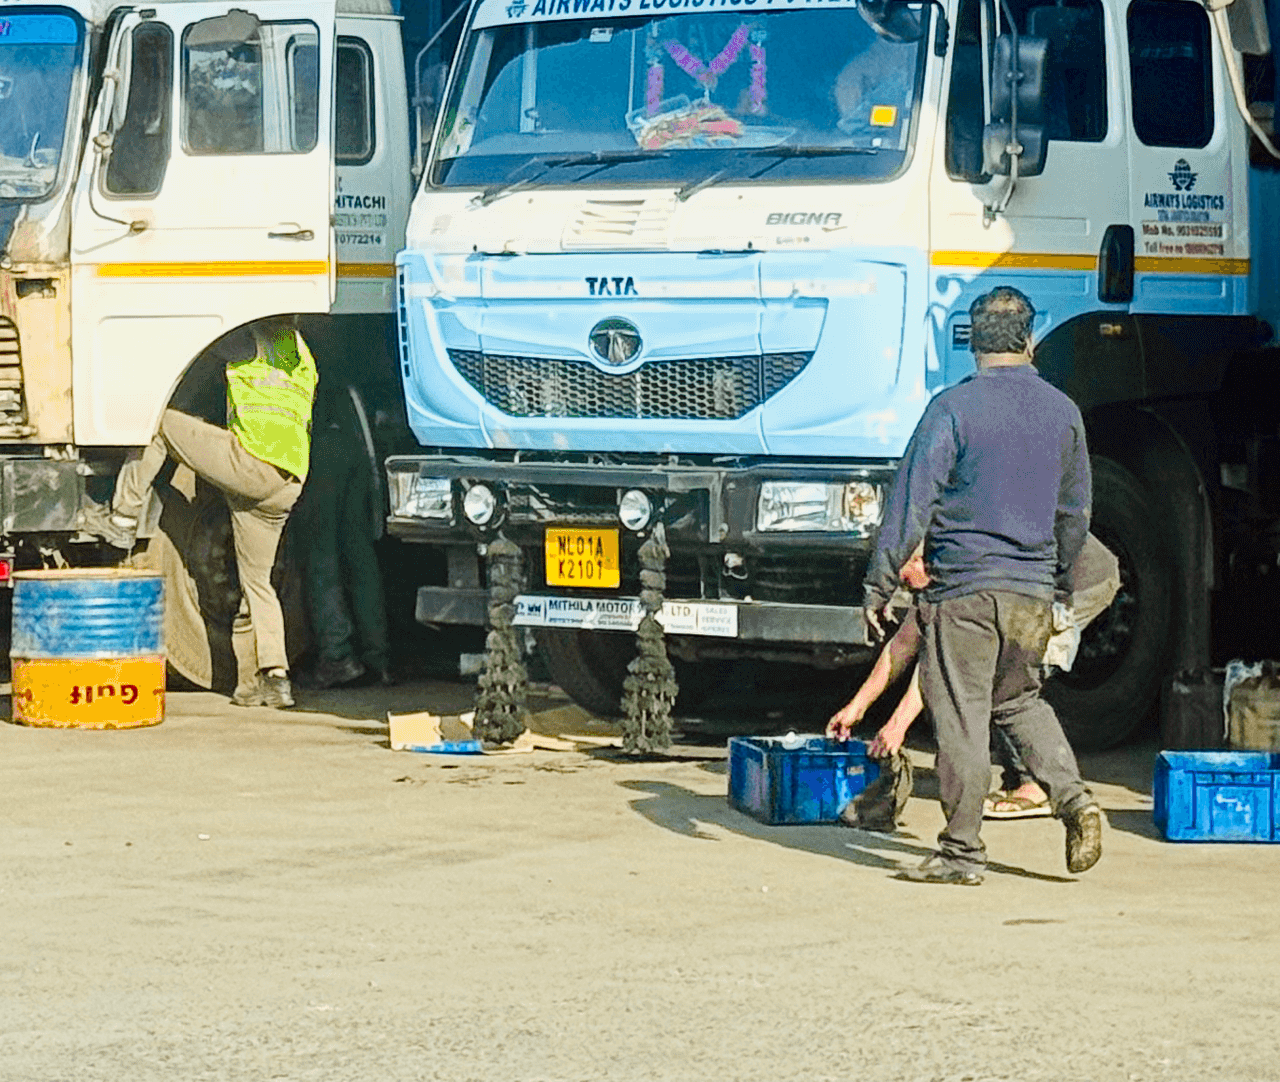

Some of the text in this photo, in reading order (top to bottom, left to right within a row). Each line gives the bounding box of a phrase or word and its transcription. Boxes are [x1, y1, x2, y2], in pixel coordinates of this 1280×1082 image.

[1144, 193, 1225, 211] AIRWAYS LOGISTICS
[584, 276, 639, 296] TATA
[558, 535, 604, 557] NL01A
[558, 560, 603, 581] K2101
[548, 599, 594, 612] MITHILA
[70, 684, 138, 704] Gulf
